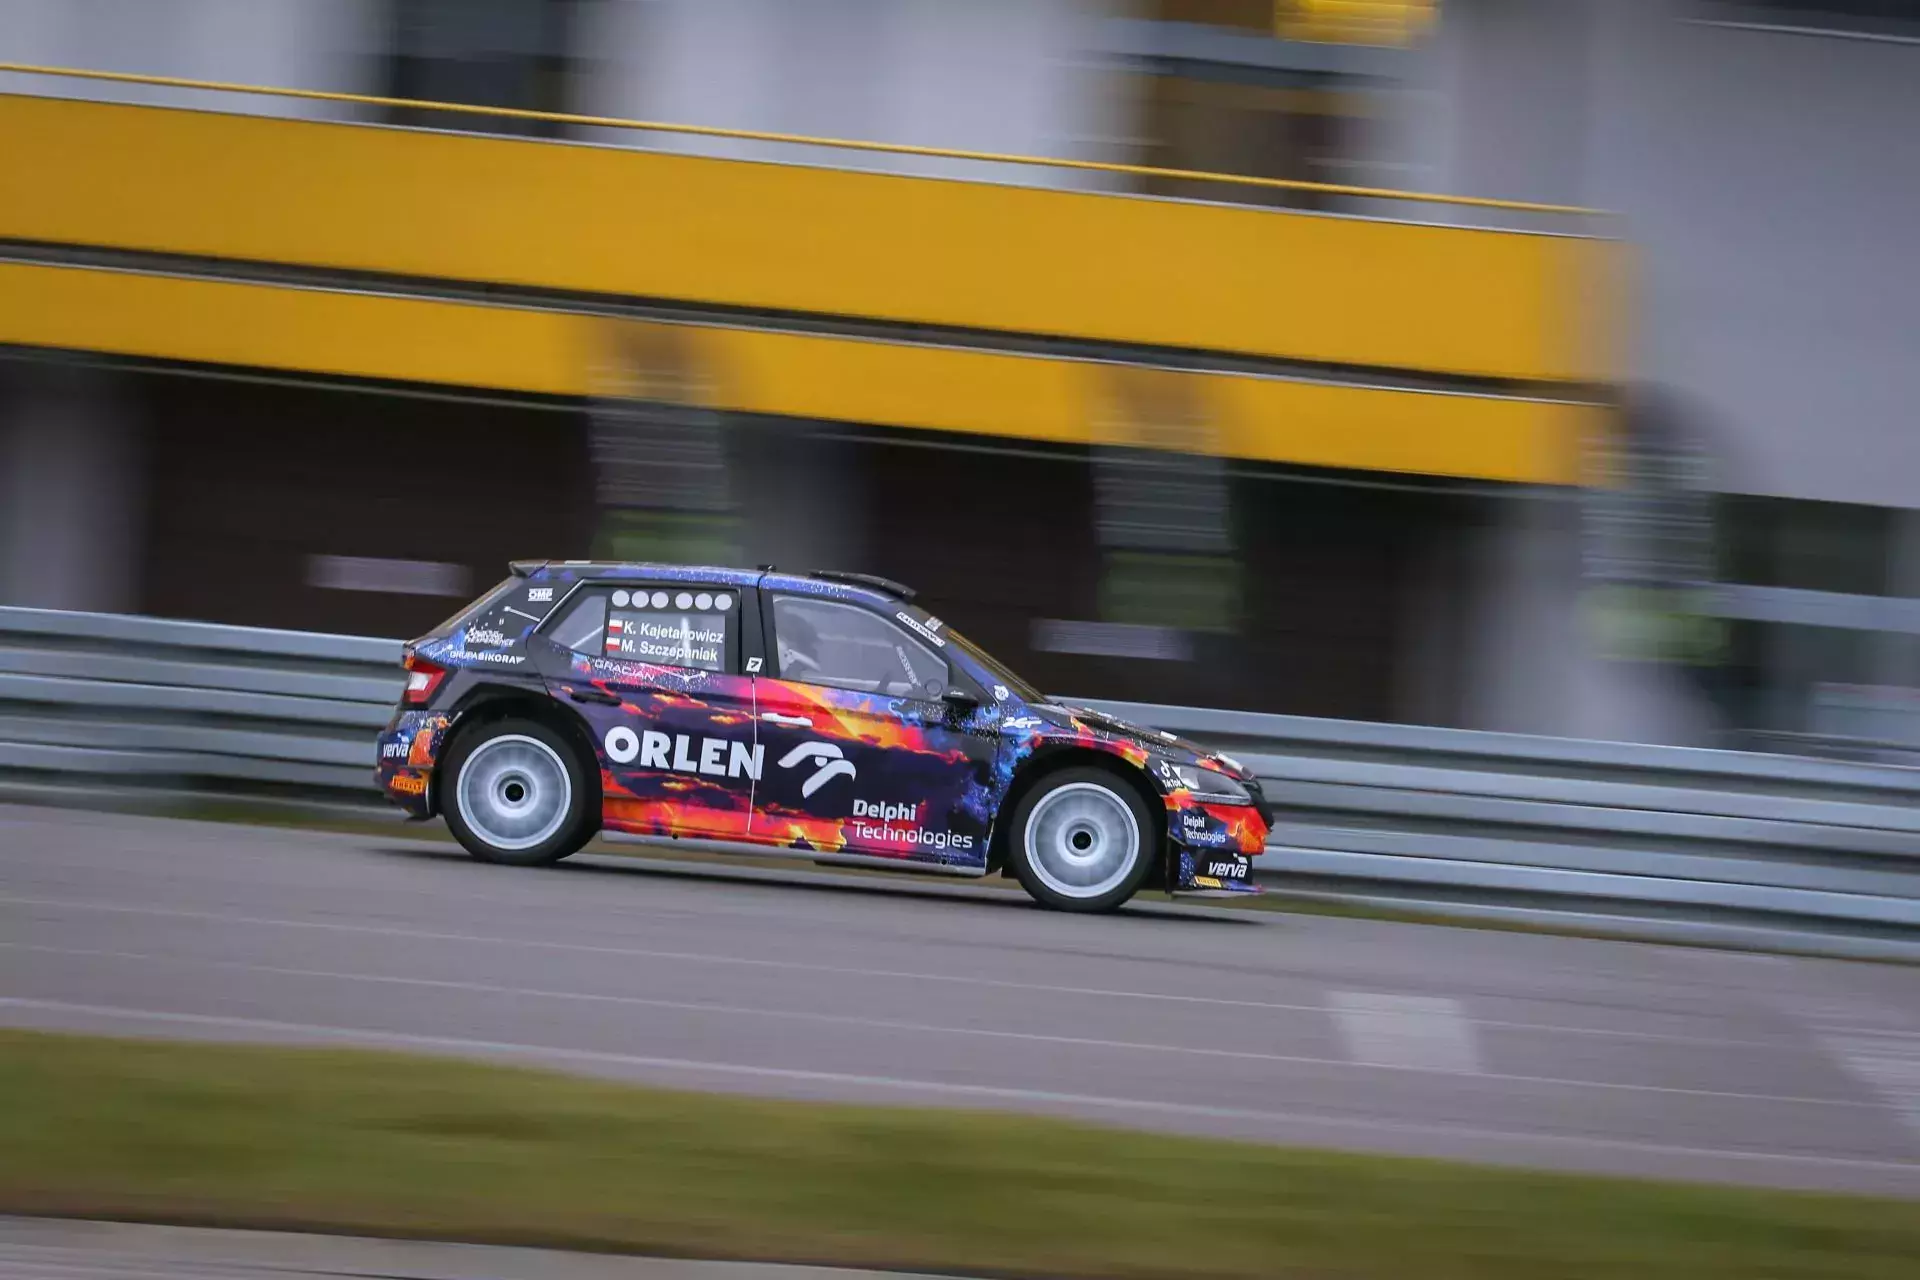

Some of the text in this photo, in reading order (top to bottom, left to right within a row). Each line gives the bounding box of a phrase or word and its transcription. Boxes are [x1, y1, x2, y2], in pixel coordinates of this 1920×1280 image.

[528, 589, 552, 600] OMP
[623, 621, 724, 644] K. Kajetanowicz
[621, 640, 718, 662] M. Szczepaniak
[383, 743, 409, 758] verva
[604, 726, 765, 781] ORLEN
[852, 799, 917, 822] Delphi
[1183, 815, 1205, 829] Delphi
[852, 820, 974, 850] Technologies
[1185, 828, 1226, 843] Technologies
[1208, 862, 1248, 877] verva
